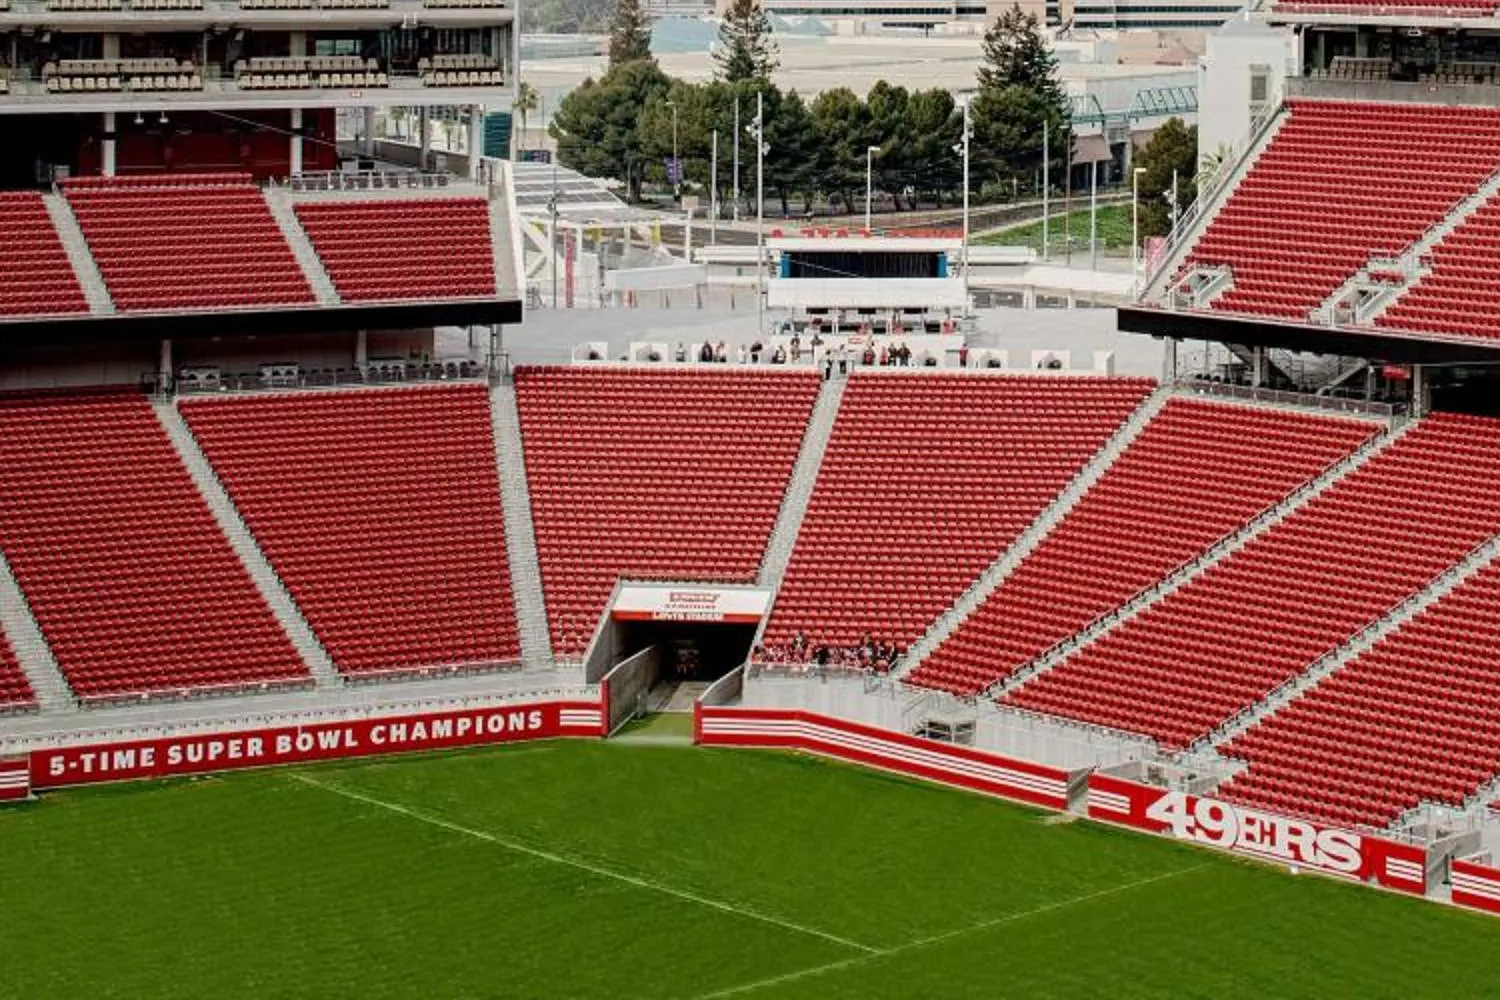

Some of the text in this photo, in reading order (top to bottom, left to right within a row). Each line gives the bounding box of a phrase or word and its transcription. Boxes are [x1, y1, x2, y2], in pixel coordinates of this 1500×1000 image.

[49, 711, 543, 775] 5-TIME SUPER BOWL CHAMPIONS
[1145, 790, 1363, 873] 49ERS
